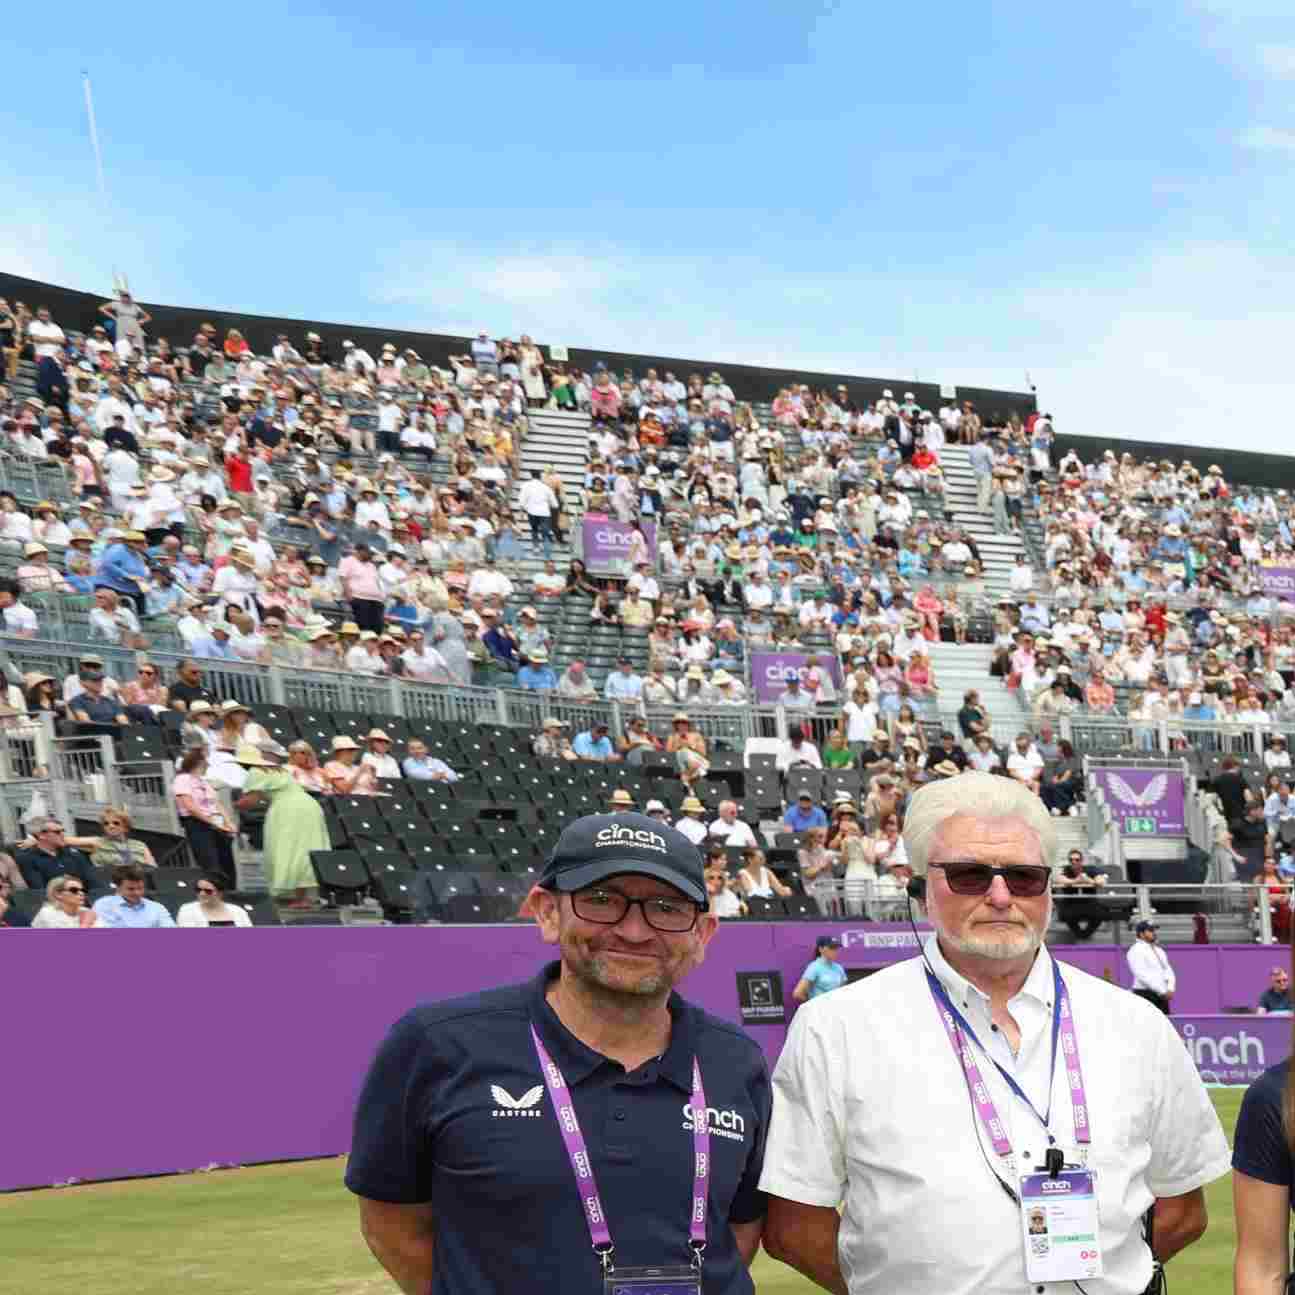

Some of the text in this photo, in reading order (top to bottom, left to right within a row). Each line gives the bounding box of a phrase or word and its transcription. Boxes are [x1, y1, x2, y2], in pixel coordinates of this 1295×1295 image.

[597, 824, 666, 847] cinch
[1183, 1024, 1264, 1064] inch
[683, 1104, 744, 1132] cnch
